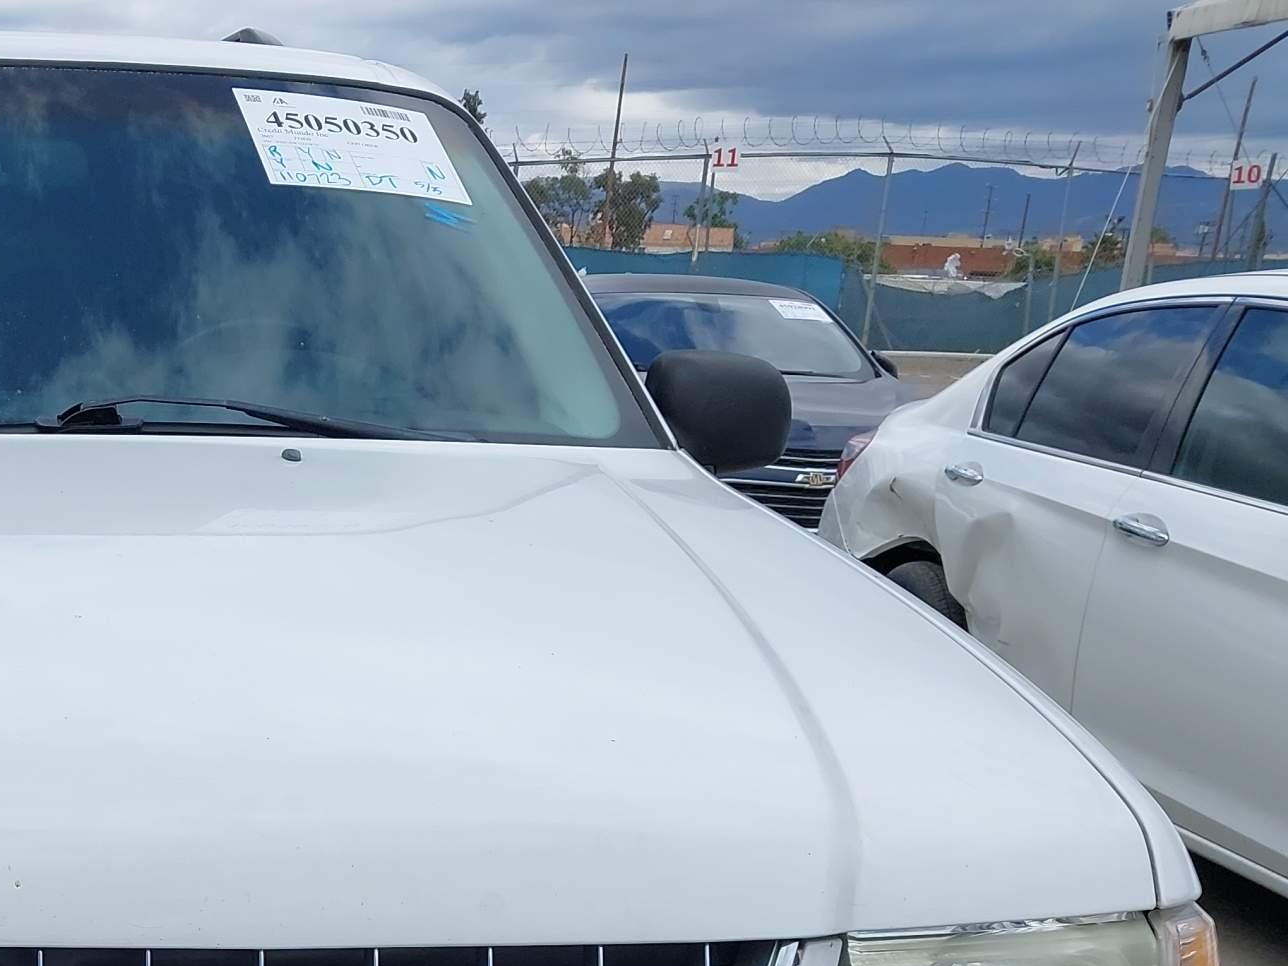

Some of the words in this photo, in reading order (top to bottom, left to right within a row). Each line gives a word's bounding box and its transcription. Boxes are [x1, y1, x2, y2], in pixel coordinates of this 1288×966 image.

[266, 111, 418, 143] 45050350
[713, 147, 738, 167] 11
[1232, 165, 1261, 184] 10
